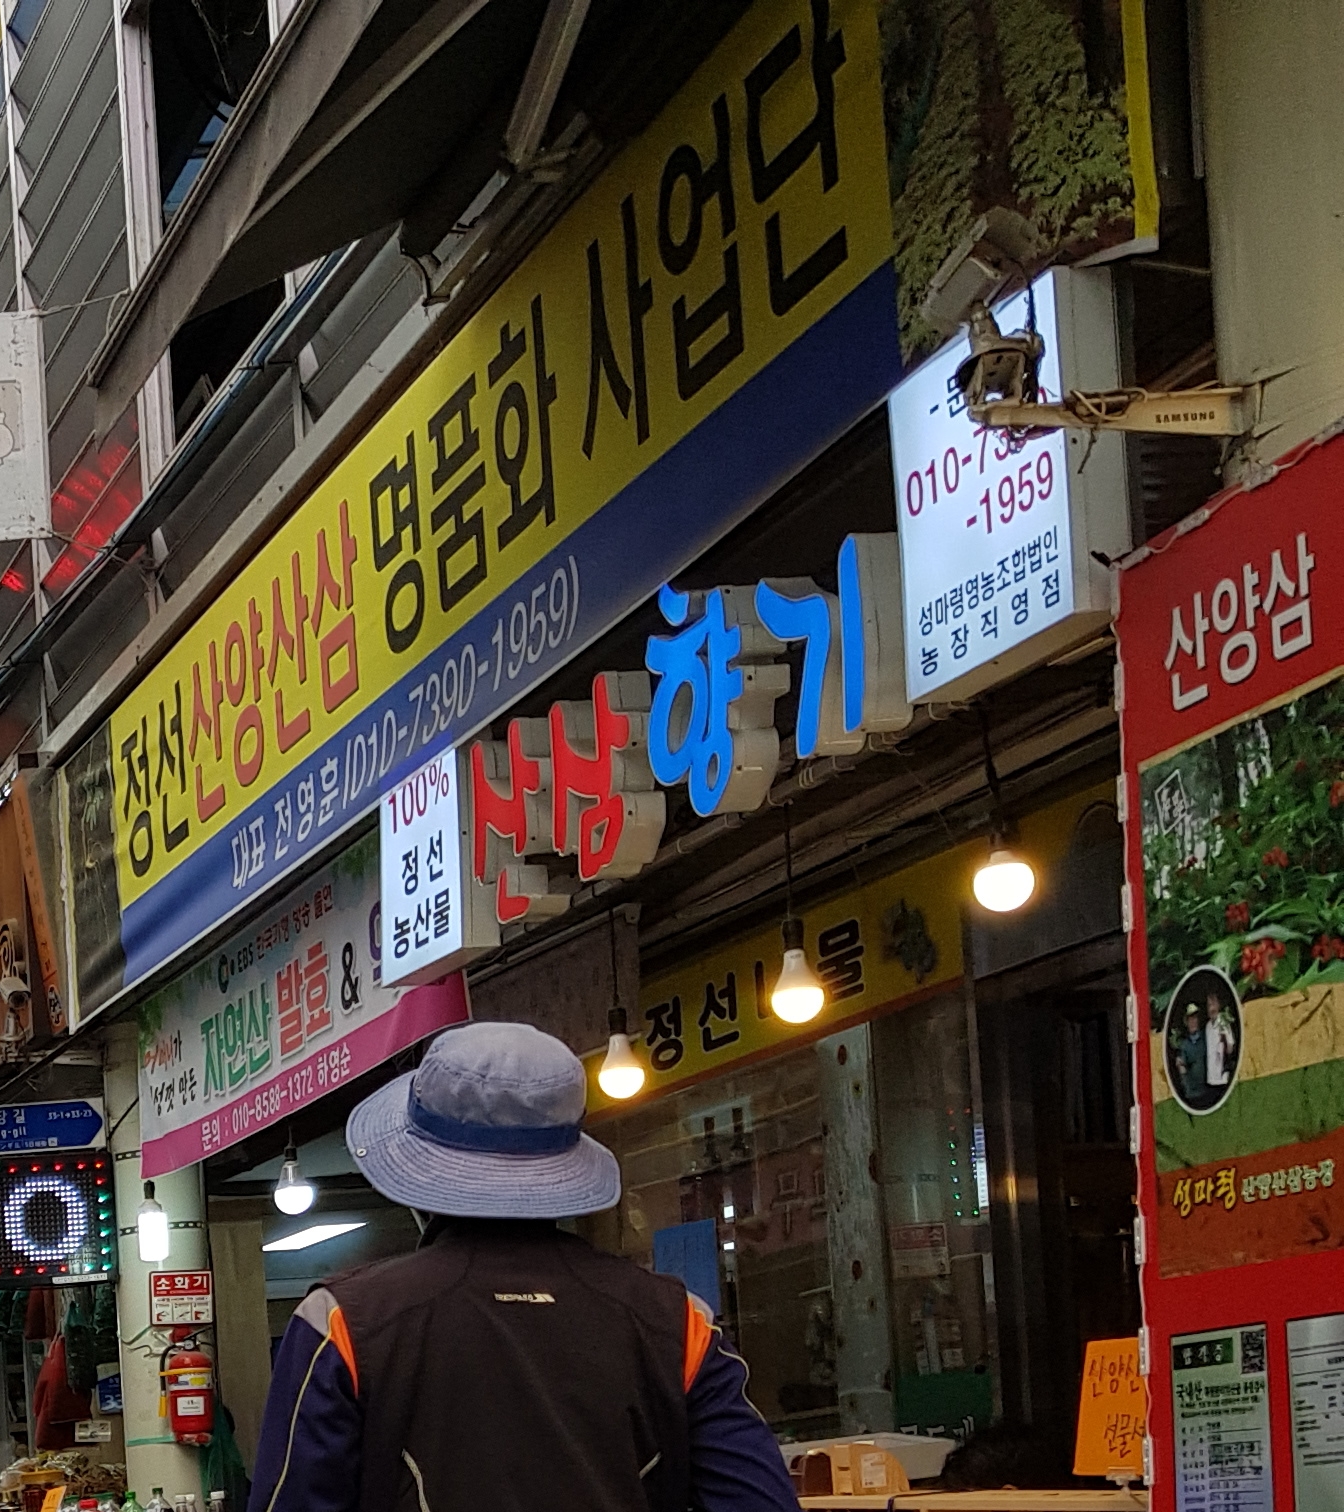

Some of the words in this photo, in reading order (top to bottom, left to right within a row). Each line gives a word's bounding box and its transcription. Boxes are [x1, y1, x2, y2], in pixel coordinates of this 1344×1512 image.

[368, 295, 558, 655] 명품화
[582, 0, 850, 461] 사업단
[1154, 410, 1216, 425] SAMSUNG
[964, 450, 1056, 537] -1959
[917, 525, 1060, 638] 성마령영농조합법인
[1164, 531, 1315, 712] 산양삼
[387, 755, 451, 835] 100%
[230, 821, 268, 891] 대표
[400, 829, 445, 897] 정선
[236, 941, 255, 974] EBS
[392, 888, 452, 960] 농산물
[200, 980, 273, 1103] 자연산
[275, 940, 333, 1059] 발효
[340, 941, 362, 1015] &
[644, 918, 866, 1073] 정선물
[150, 1079, 176, 1117] 성껏
[178, 1067, 199, 1106] 만든
[200, 1119, 222, 1152] 문의
[231, 1066, 315, 1136] 010-8588-1372
[316, 1042, 352, 1087] 하영순
[1172, 1166, 1238, 1218] 성마령
[155, 1274, 208, 1290] 소화기
